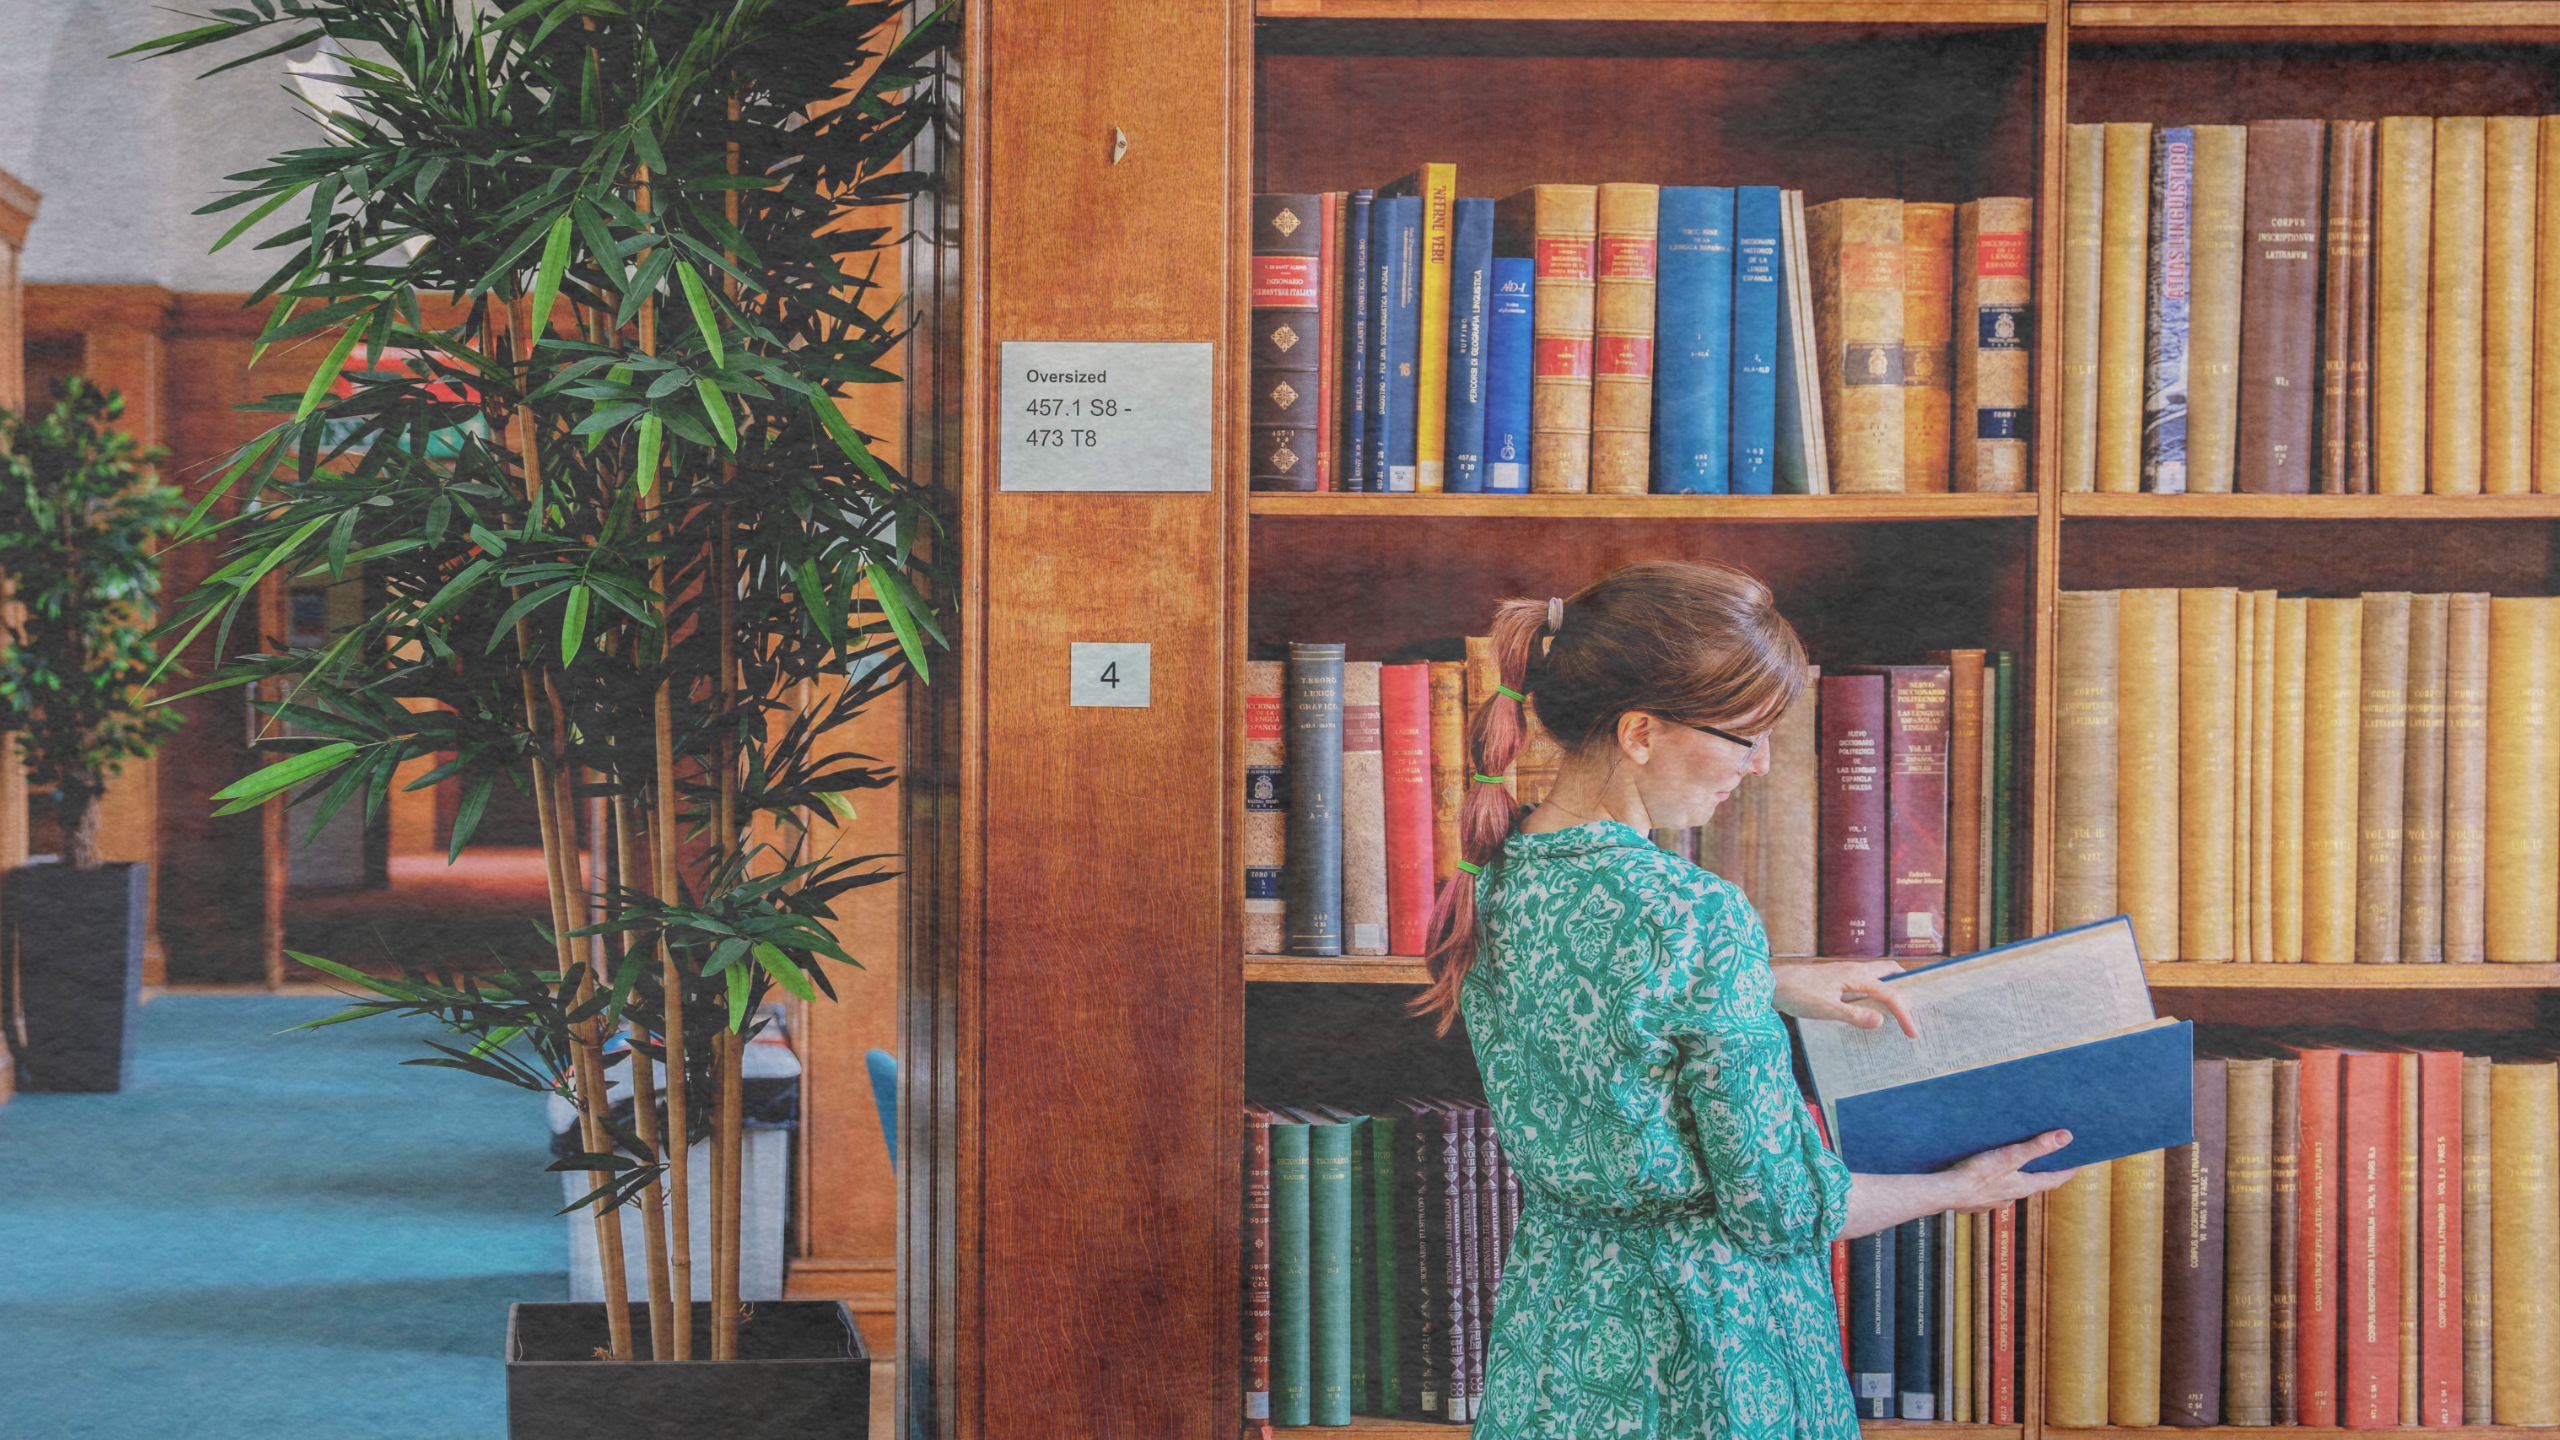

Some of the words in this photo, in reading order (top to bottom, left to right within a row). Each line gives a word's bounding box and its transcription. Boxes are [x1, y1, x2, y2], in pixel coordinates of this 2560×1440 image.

[2271, 217, 2305, 227] CORPVS
[1431, 236, 1445, 264] VERU
[2265, 250, 2308, 259] LATINARVM
[2166, 250, 2185, 299] ATLAS
[1358, 278, 1366, 315] FONETICO
[1473, 269, 1482, 313] LINGUISTICA
[1471, 315, 1479, 356] GEOGRAFIA
[1026, 369, 1107, 383] Oversized
[1471, 358, 1478, 366] DI
[1470, 367, 1478, 403] PERCORSI
[1026, 398, 1080, 416] 457.1
[1090, 398, 1117, 416] S8
[1026, 429, 1064, 447] 473
[1070, 429, 1097, 447] T8
[1100, 661, 1120, 689] 4
[2191, 1141, 2199, 1183] LATINARUM
[2200, 1176, 2208, 1196] FASC
[2368, 1184, 2375, 1192] VI
[1418, 1197, 1426, 1239] ILUSTRADO
[1462, 1193, 1471, 1235] ILUSTRADO
[1481, 1193, 1490, 1235] ILUSTRADO
[2191, 1185, 2199, 1238] INSCRIPTIONUM
[2200, 1233, 2207, 1241] VI
[1464, 1238, 1472, 1279] DICIONÁRIO
[2190, 1240, 2198, 1268] CORPUS
[1456, 1275, 1462, 1284] DA
[1494, 1269, 1500, 1278] DA
[2367, 1259, 2375, 1312] INSCRIPTIONUM
[2438, 1245, 2446, 1299] INSCRIPTIONUM
[2438, 1299, 2446, 1328] CORPUS
[2367, 1314, 2375, 1343] CORPUS
